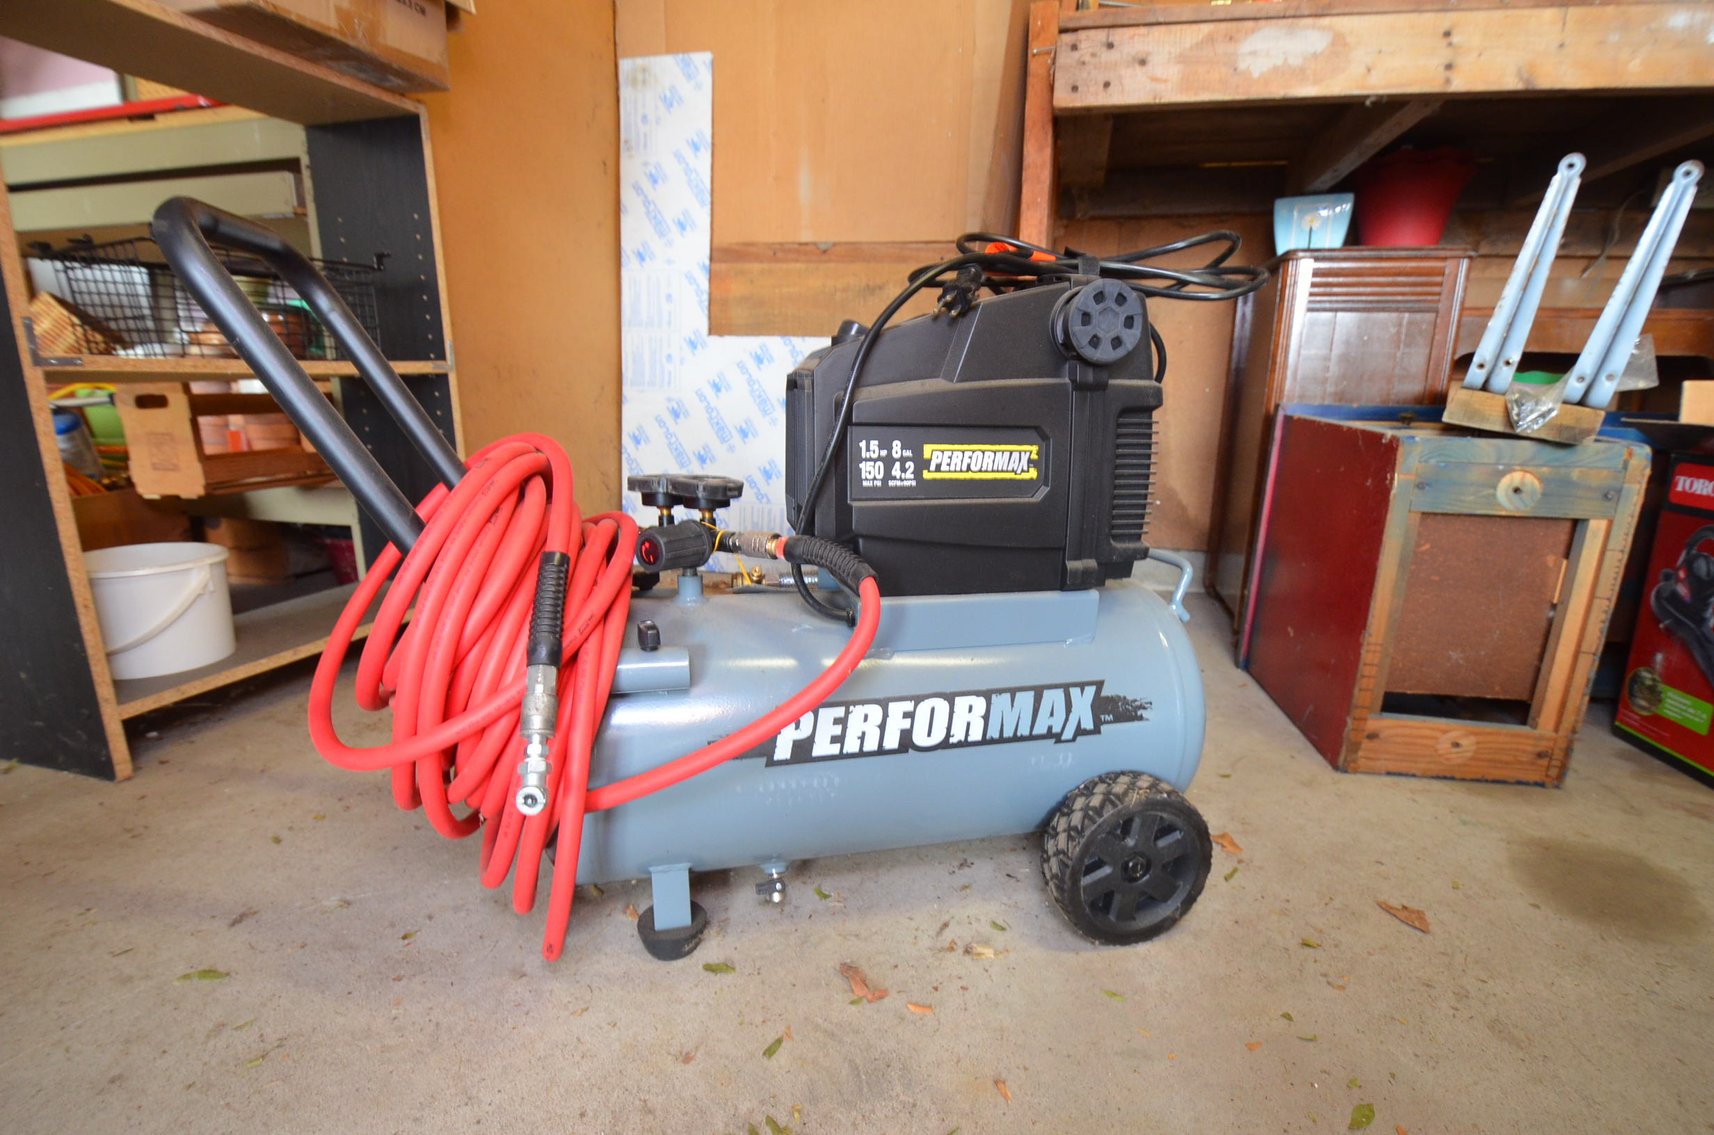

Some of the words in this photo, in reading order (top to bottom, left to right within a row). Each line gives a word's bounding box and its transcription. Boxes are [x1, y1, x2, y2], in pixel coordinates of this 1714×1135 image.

[859, 440, 879, 459] 1.5
[892, 440, 902, 459] 8
[859, 461, 884, 480] 150
[891, 461, 915, 480] 4.2
[929, 450, 1030, 474] PERFORMAX
[773, 685, 1097, 761] PERFORMAX
